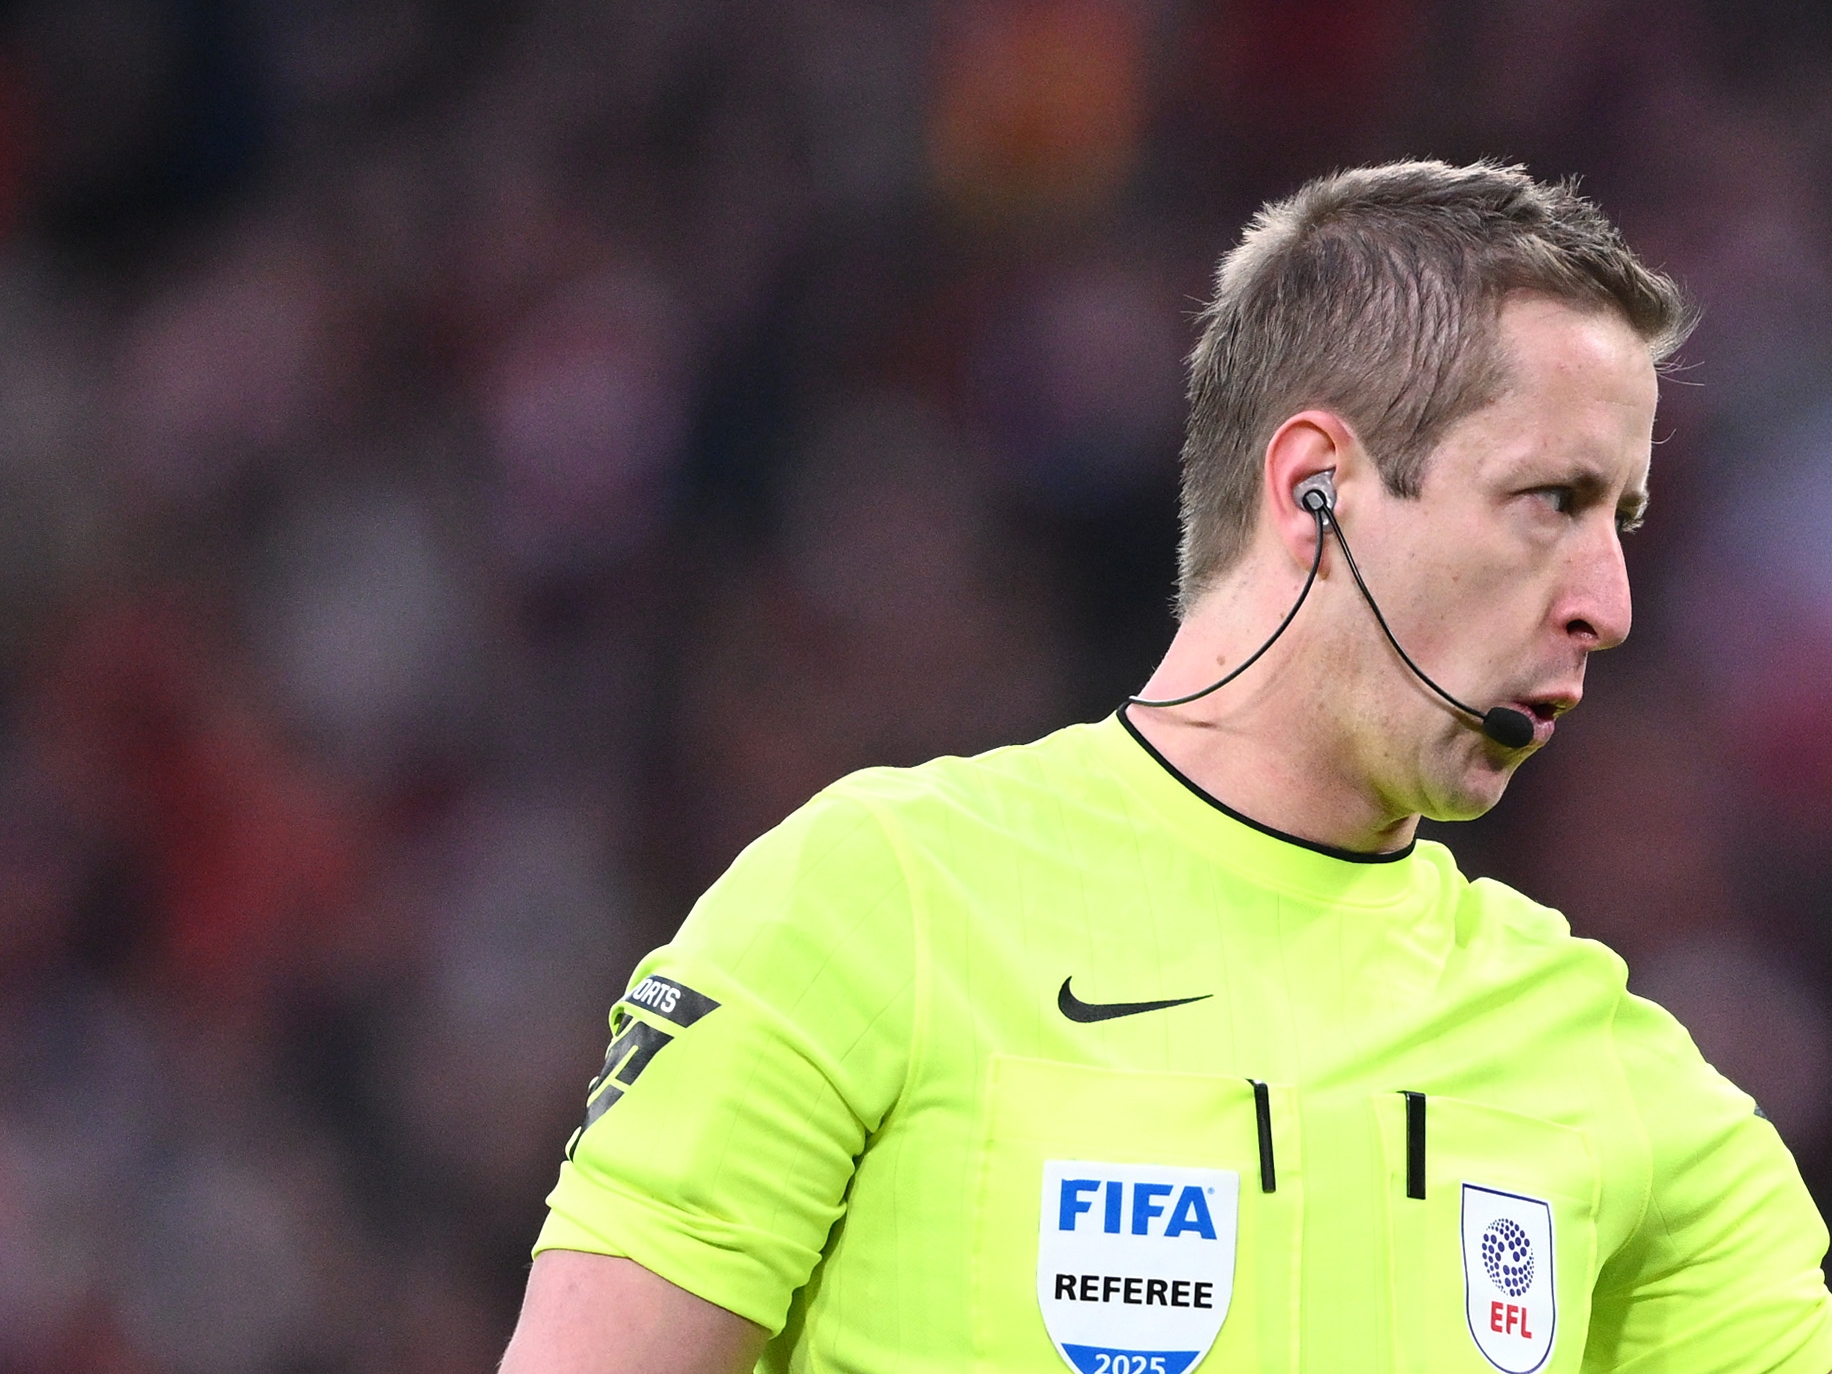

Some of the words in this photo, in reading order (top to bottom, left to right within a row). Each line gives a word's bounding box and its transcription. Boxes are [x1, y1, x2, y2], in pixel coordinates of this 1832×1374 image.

[632, 978, 681, 1013] ORTS
[1058, 1178, 1218, 1241] FIFA
[1054, 1273, 1214, 1310] REFEREE
[1490, 1300, 1533, 1340] EFL
